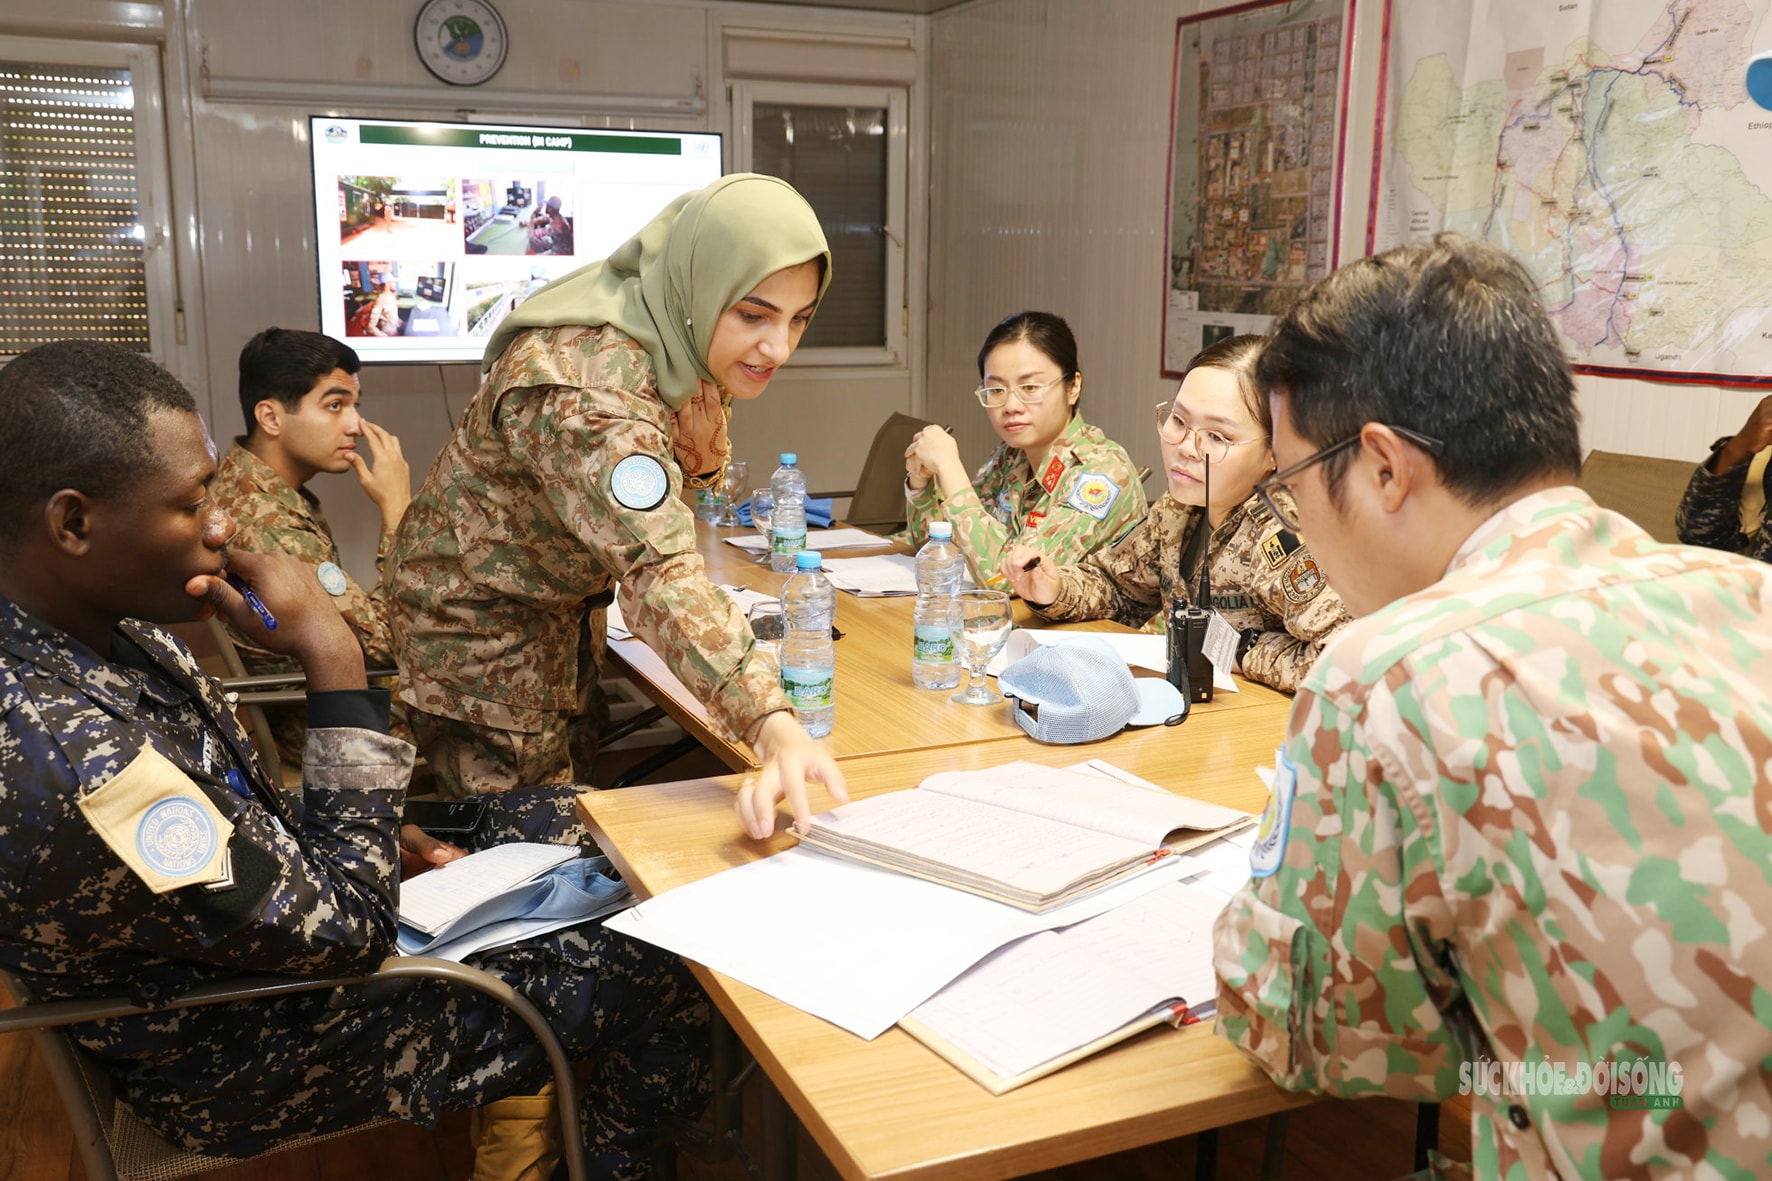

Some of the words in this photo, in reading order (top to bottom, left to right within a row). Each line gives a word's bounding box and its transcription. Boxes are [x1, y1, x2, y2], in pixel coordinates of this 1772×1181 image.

[479, 134, 531, 146] PREVENTION
[1210, 595, 1250, 609] GOLIA
[160, 806, 195, 819] NATIONS
